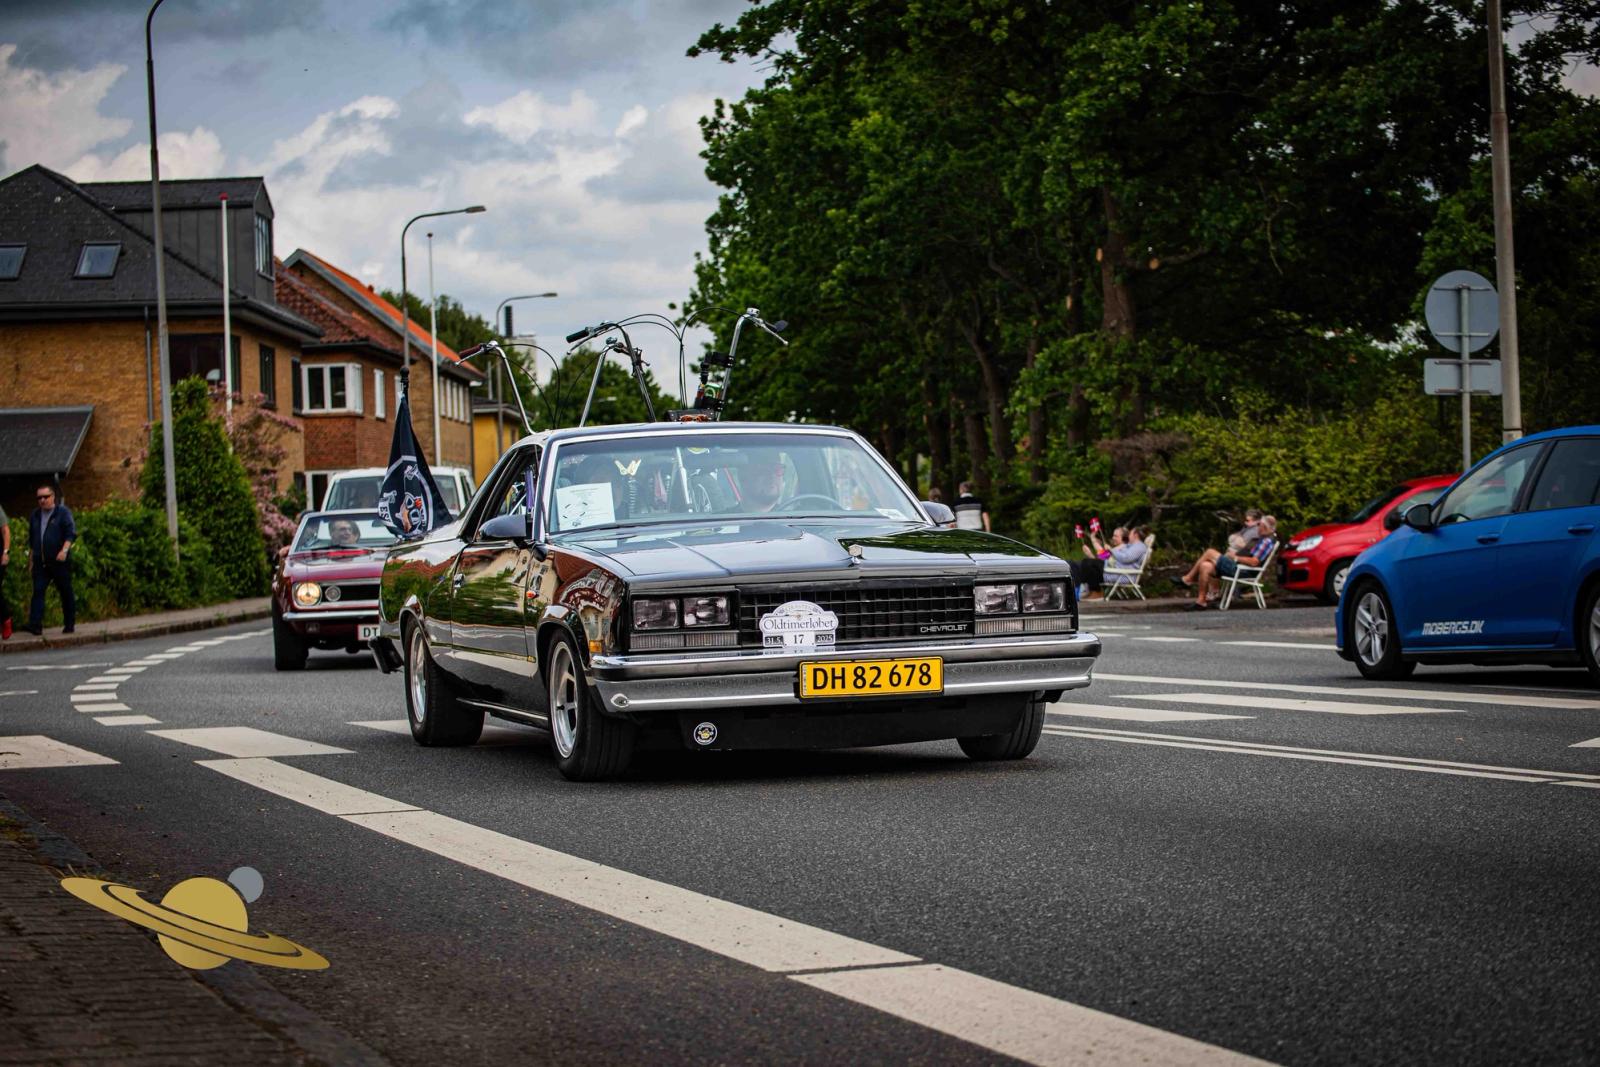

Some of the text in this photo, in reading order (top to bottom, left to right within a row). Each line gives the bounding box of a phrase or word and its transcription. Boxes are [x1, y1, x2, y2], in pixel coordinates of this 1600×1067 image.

[363, 627, 379, 637] DT
[920, 624, 968, 633] CHEVROLET
[793, 634, 805, 644] 17
[817, 634, 833, 643] 2025
[812, 666, 846, 690] DH
[852, 666, 882, 689] 82
[888, 663, 932, 687] 678
